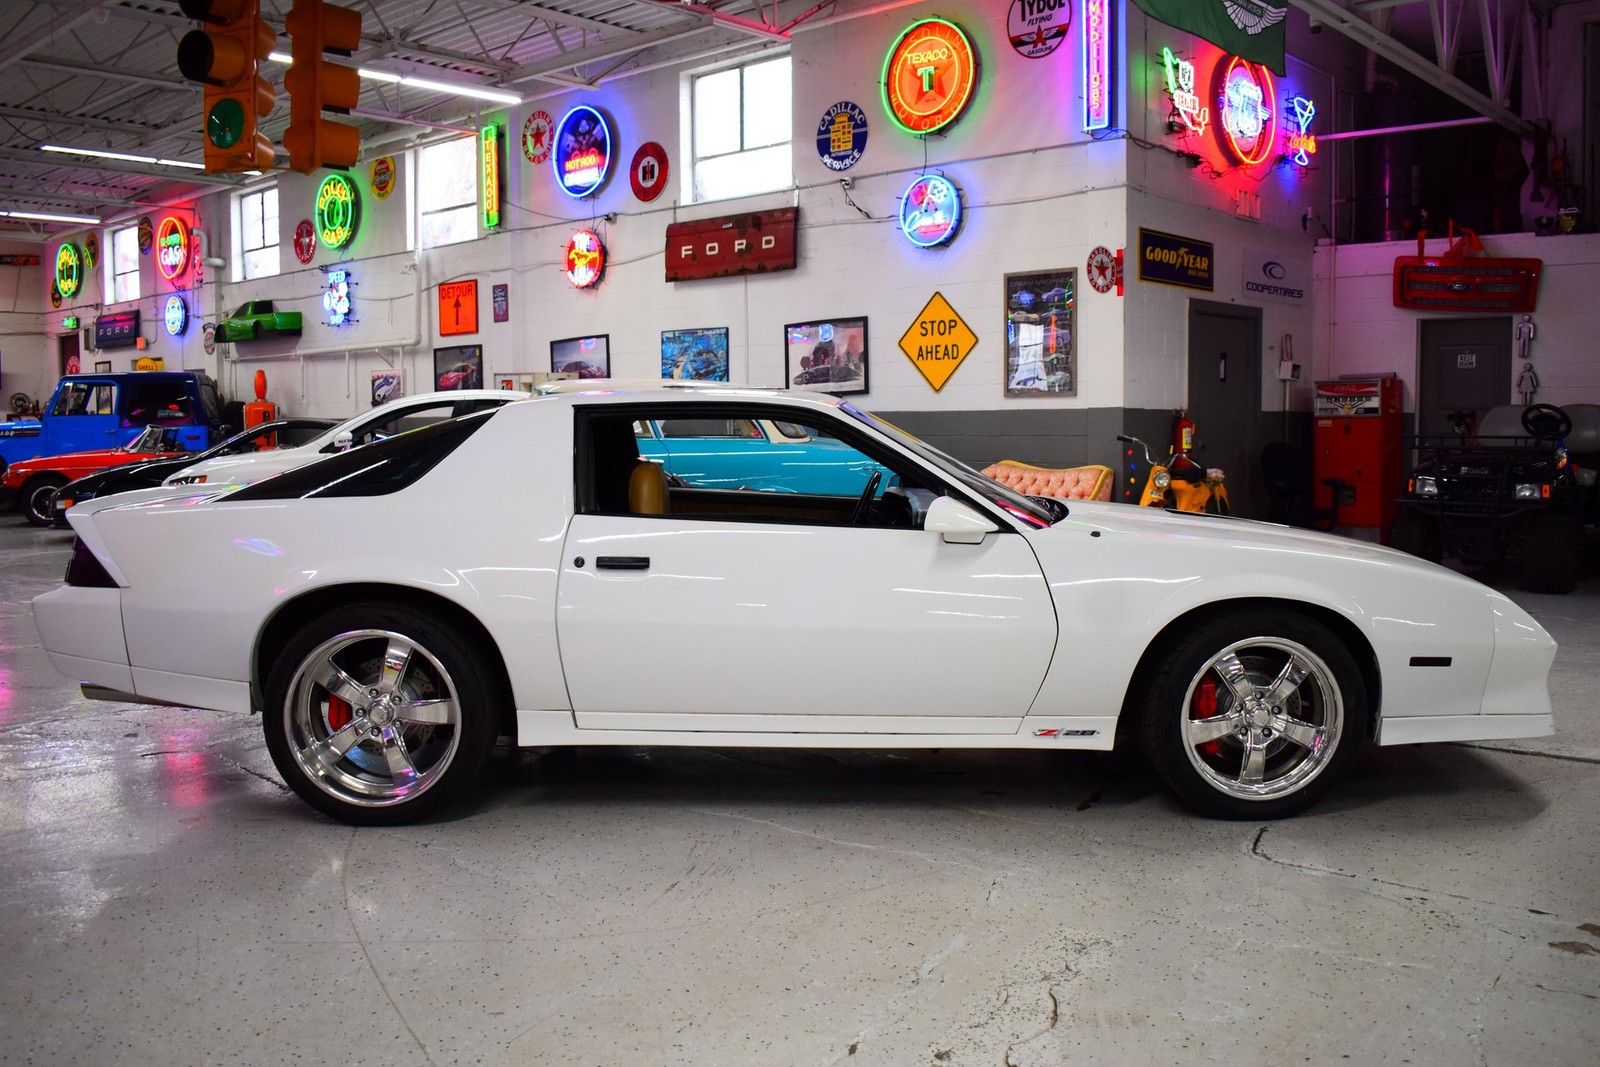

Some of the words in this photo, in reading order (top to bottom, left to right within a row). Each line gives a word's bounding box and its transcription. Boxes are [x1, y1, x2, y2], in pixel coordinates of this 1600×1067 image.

[1027, 14, 1053, 26] FLYING
[906, 47, 949, 65] TEXACO
[1026, 45, 1053, 56] GASOLINE
[917, 65, 935, 92] T
[820, 102, 865, 131] CADILLAC
[891, 92, 944, 130] MOTOR
[565, 159, 580, 171] HOT
[819, 148, 861, 170] SERVICE
[485, 139, 494, 210] TEXACO
[323, 226, 344, 244] GAS
[160, 245, 181, 266] GAS
[681, 235, 775, 259] FORD
[1145, 246, 1209, 271] GOODYEAR
[441, 284, 473, 300] DETOUR
[100, 325, 130, 336] FORD
[919, 319, 958, 337] STOP
[916, 344, 960, 361] AHEAD
